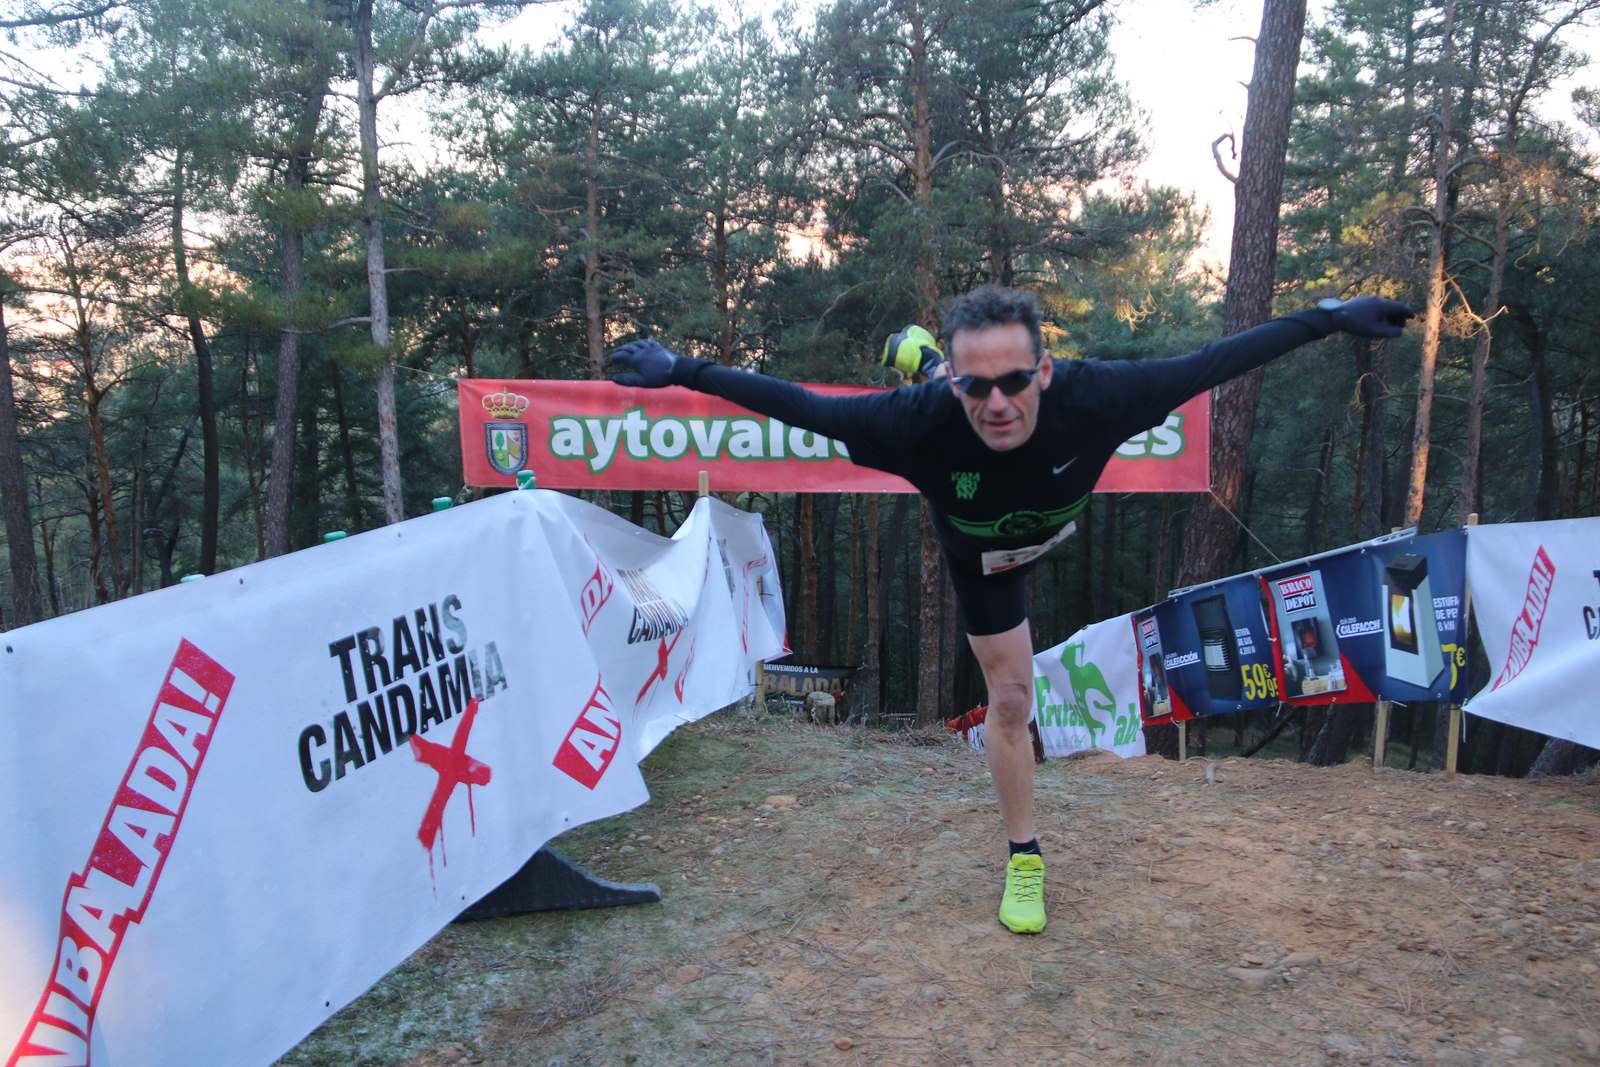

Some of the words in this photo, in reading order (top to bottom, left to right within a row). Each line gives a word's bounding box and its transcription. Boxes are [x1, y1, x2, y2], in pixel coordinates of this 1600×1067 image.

[550, 408, 850, 472] aytovald
[1279, 579, 1312, 595] BRICO
[328, 594, 468, 704] TRANS
[298, 640, 508, 793] CANDAMIA
